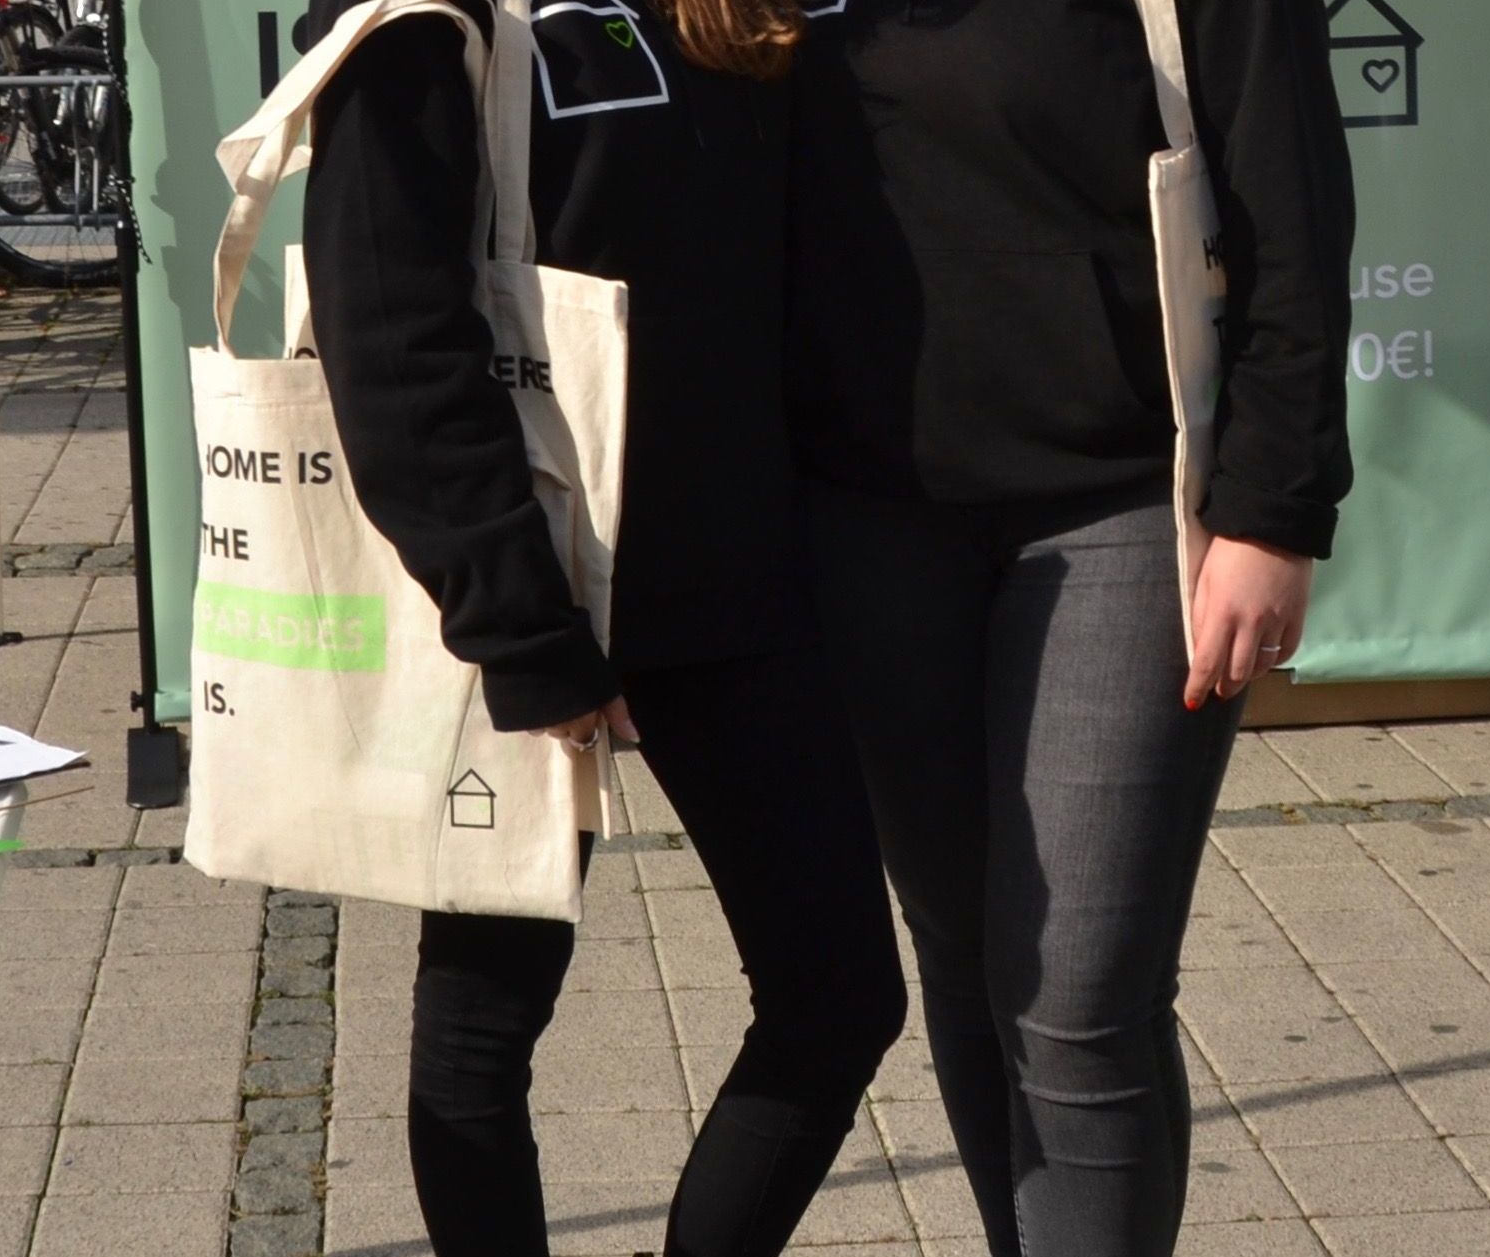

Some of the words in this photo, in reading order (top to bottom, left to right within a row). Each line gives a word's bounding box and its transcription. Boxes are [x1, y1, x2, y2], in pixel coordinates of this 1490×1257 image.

[298, 451, 333, 485] IS
[202, 522, 250, 561] THE
[204, 681, 235, 717] IS.
